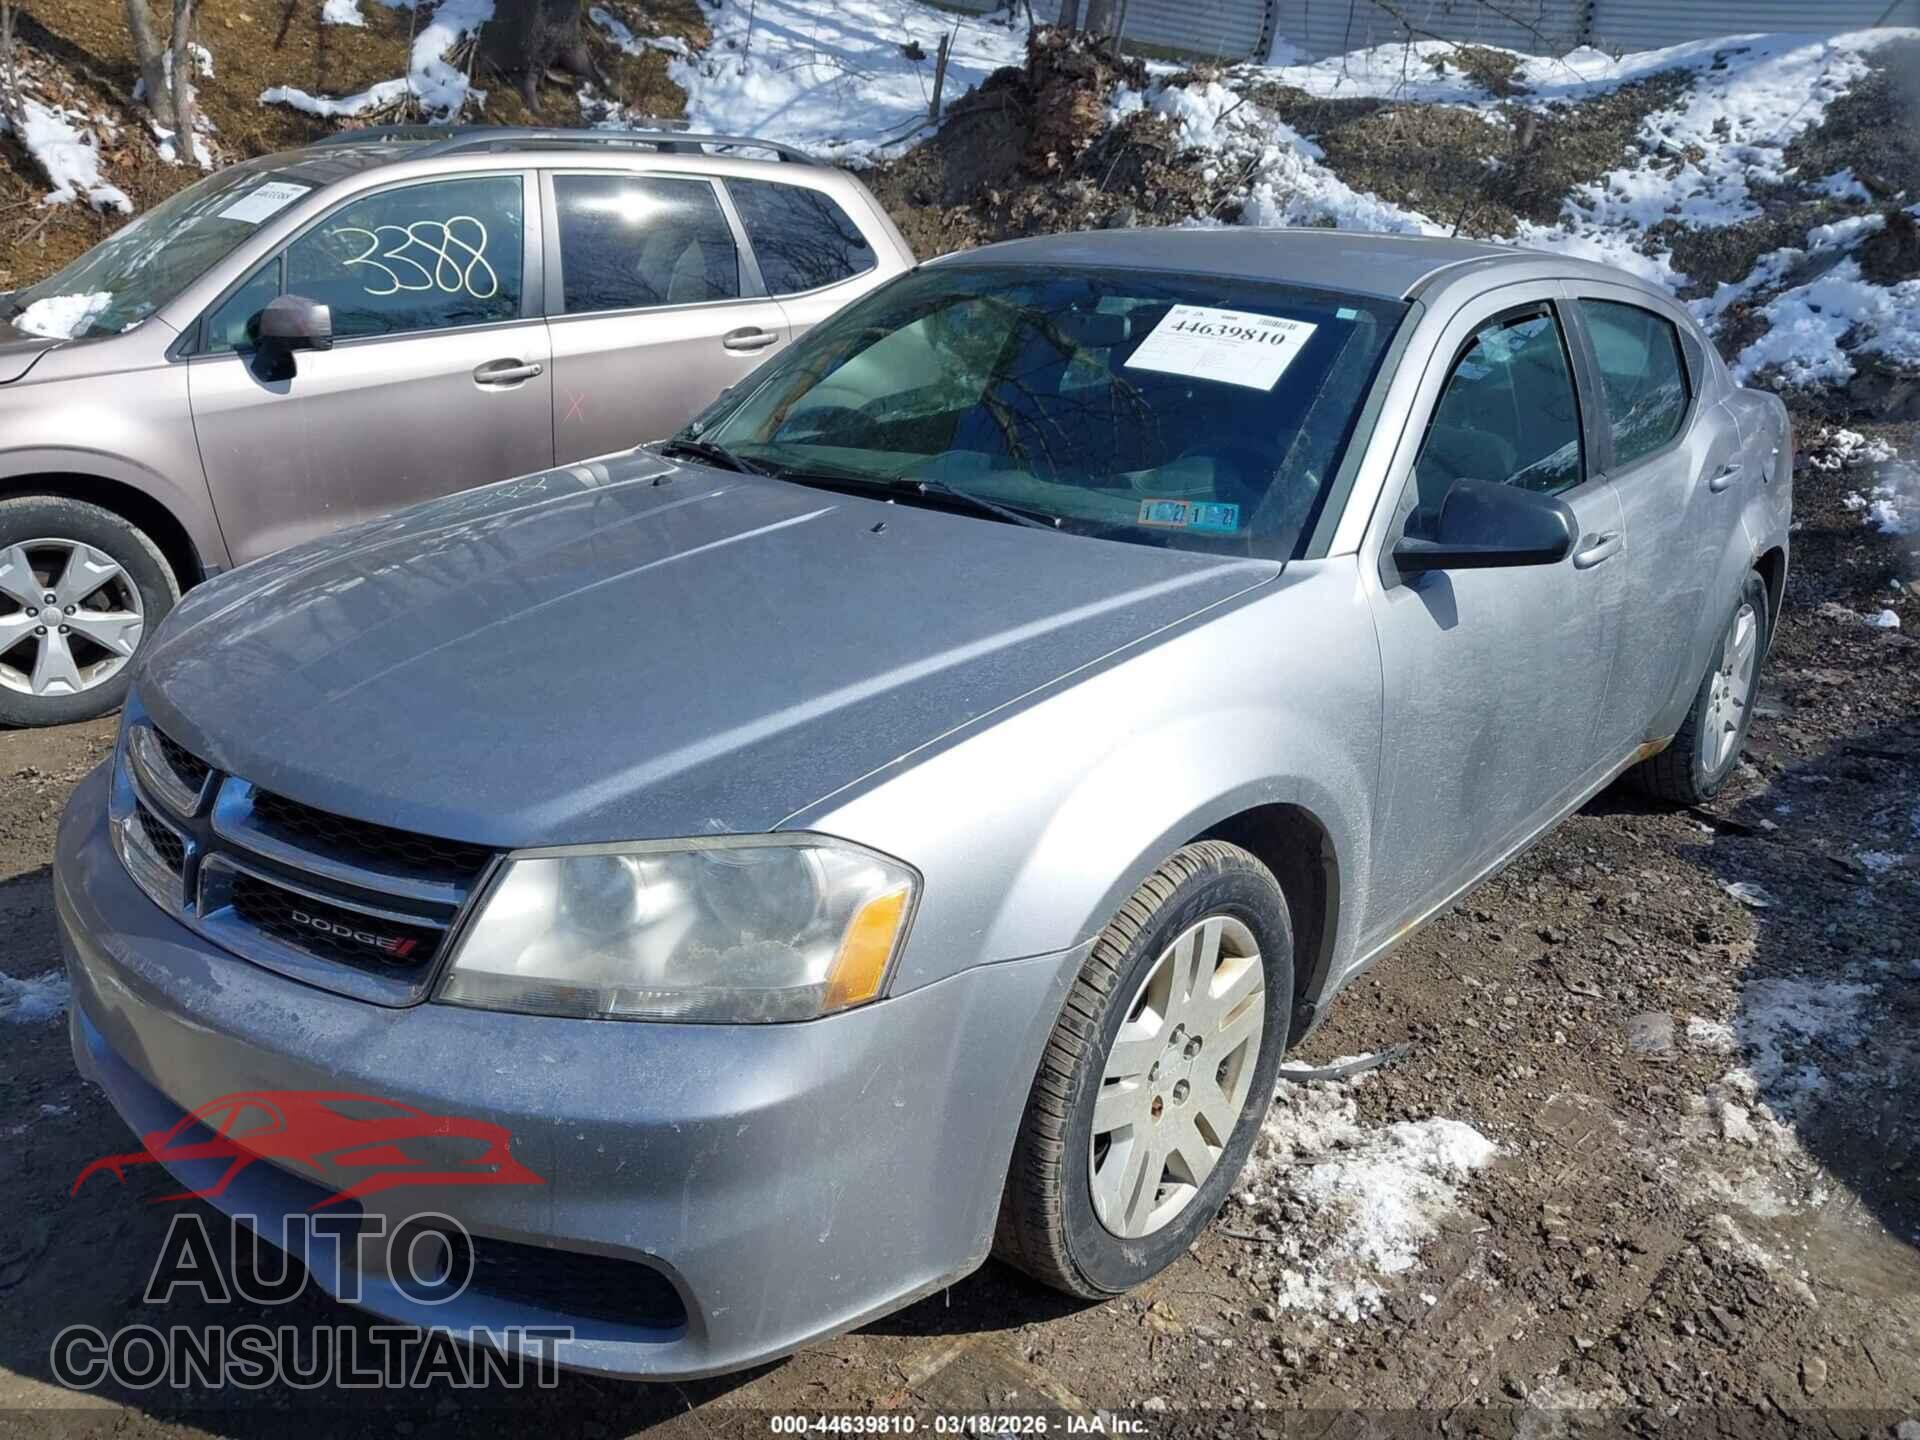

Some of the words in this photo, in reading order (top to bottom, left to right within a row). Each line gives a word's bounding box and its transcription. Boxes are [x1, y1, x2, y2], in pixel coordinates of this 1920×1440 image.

[332, 215, 498, 299] 3388
[1171, 319, 1287, 347] 44639810
[292, 910, 399, 951] DODGE
